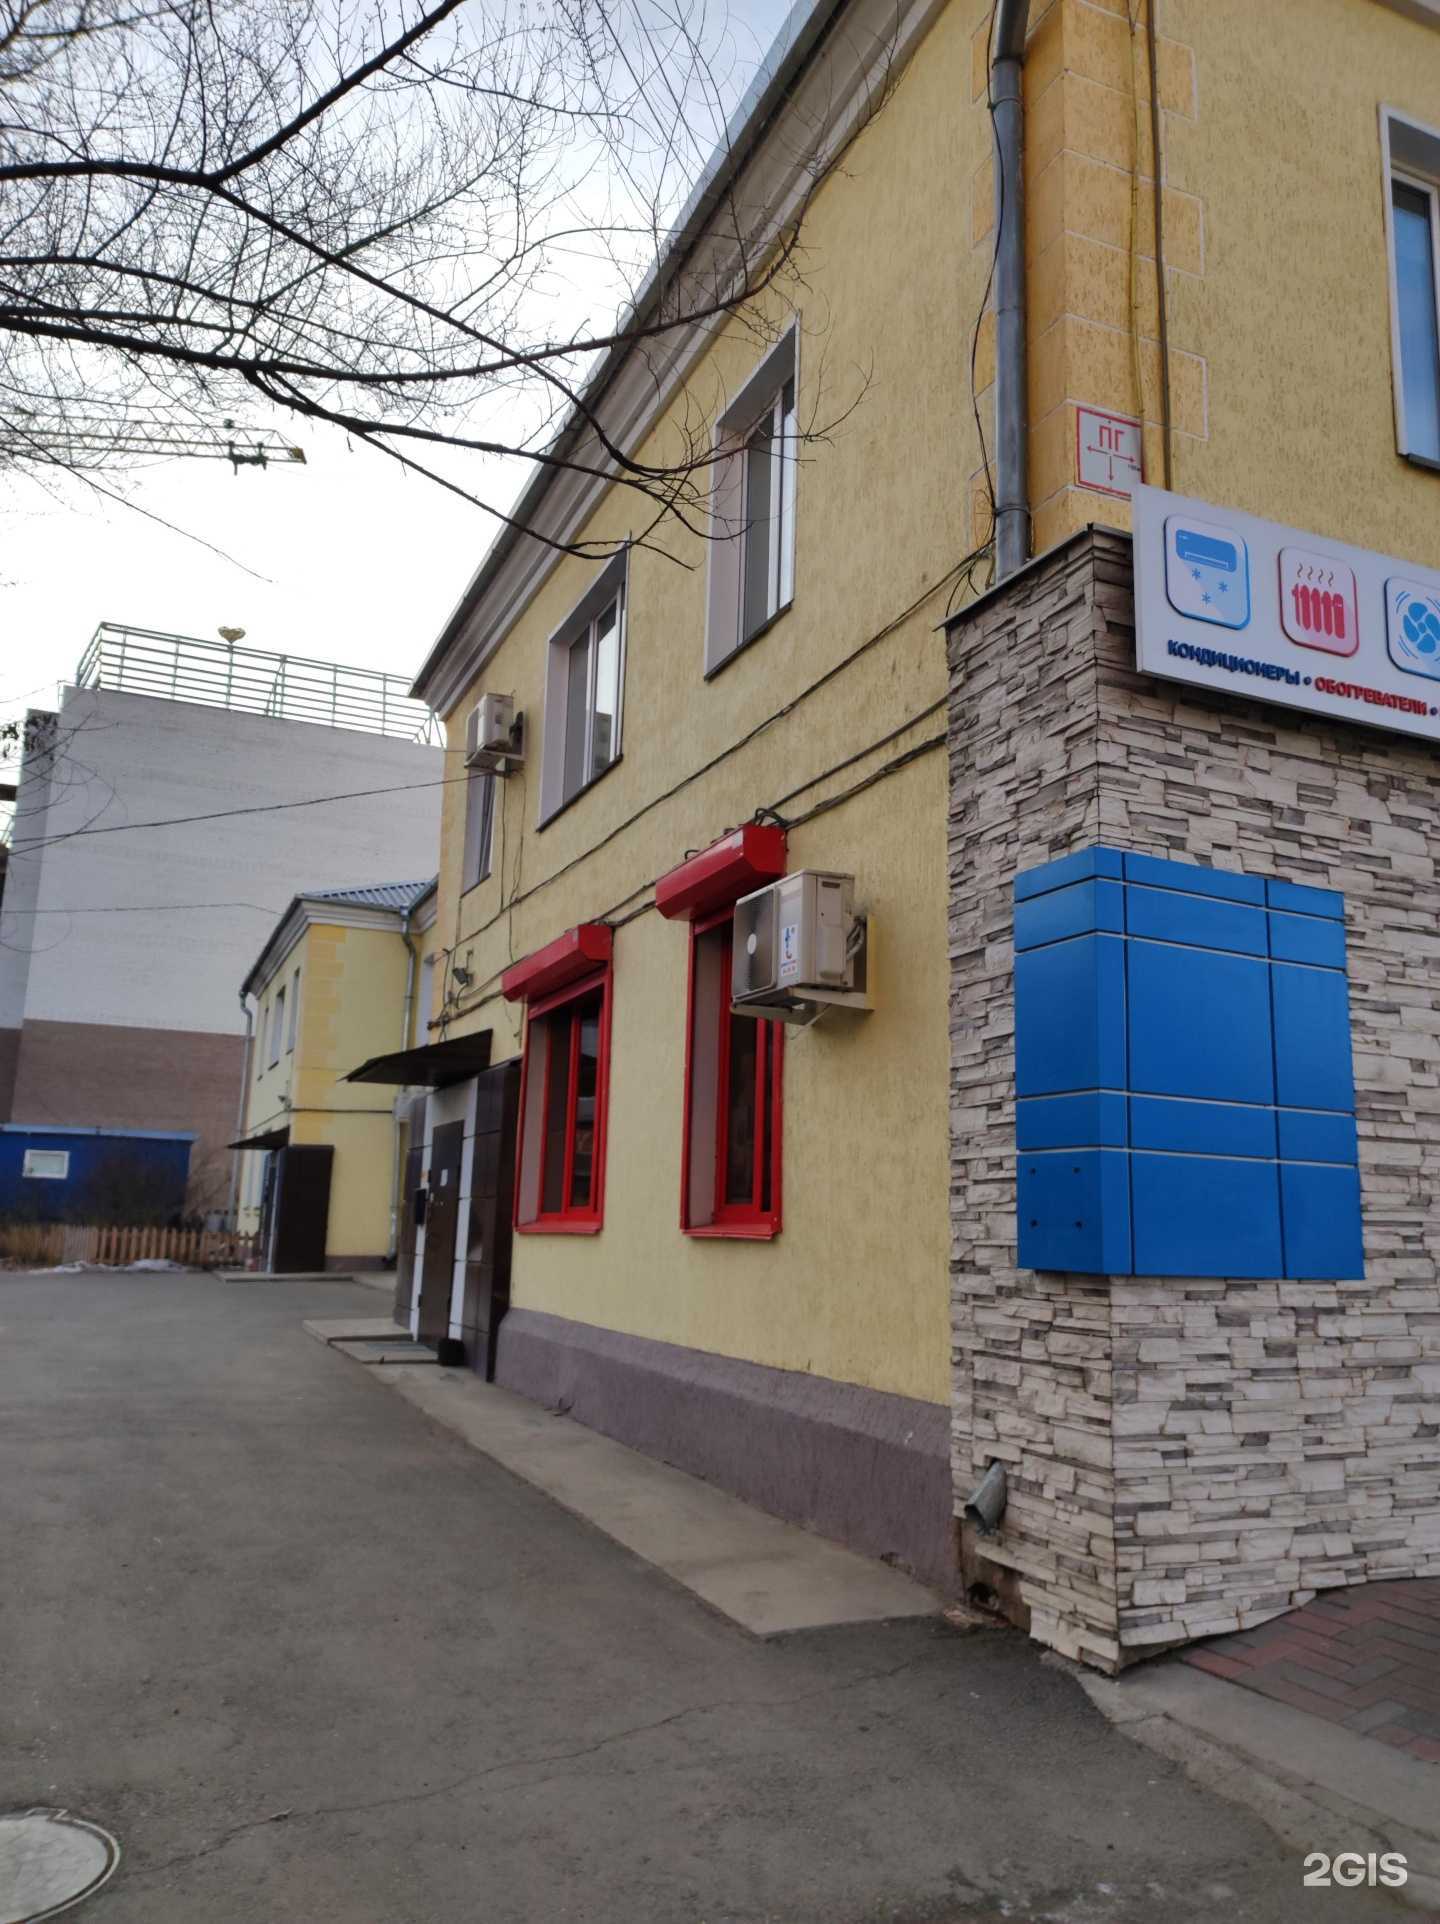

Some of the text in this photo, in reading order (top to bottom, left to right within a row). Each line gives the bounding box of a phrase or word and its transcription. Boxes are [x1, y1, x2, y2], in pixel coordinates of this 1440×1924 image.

[1099, 424, 1125, 452] ПГ
[1167, 639, 1428, 716] КОНДИЦИОНЕРЫ ОБОГРЕВАТЕЛИ
